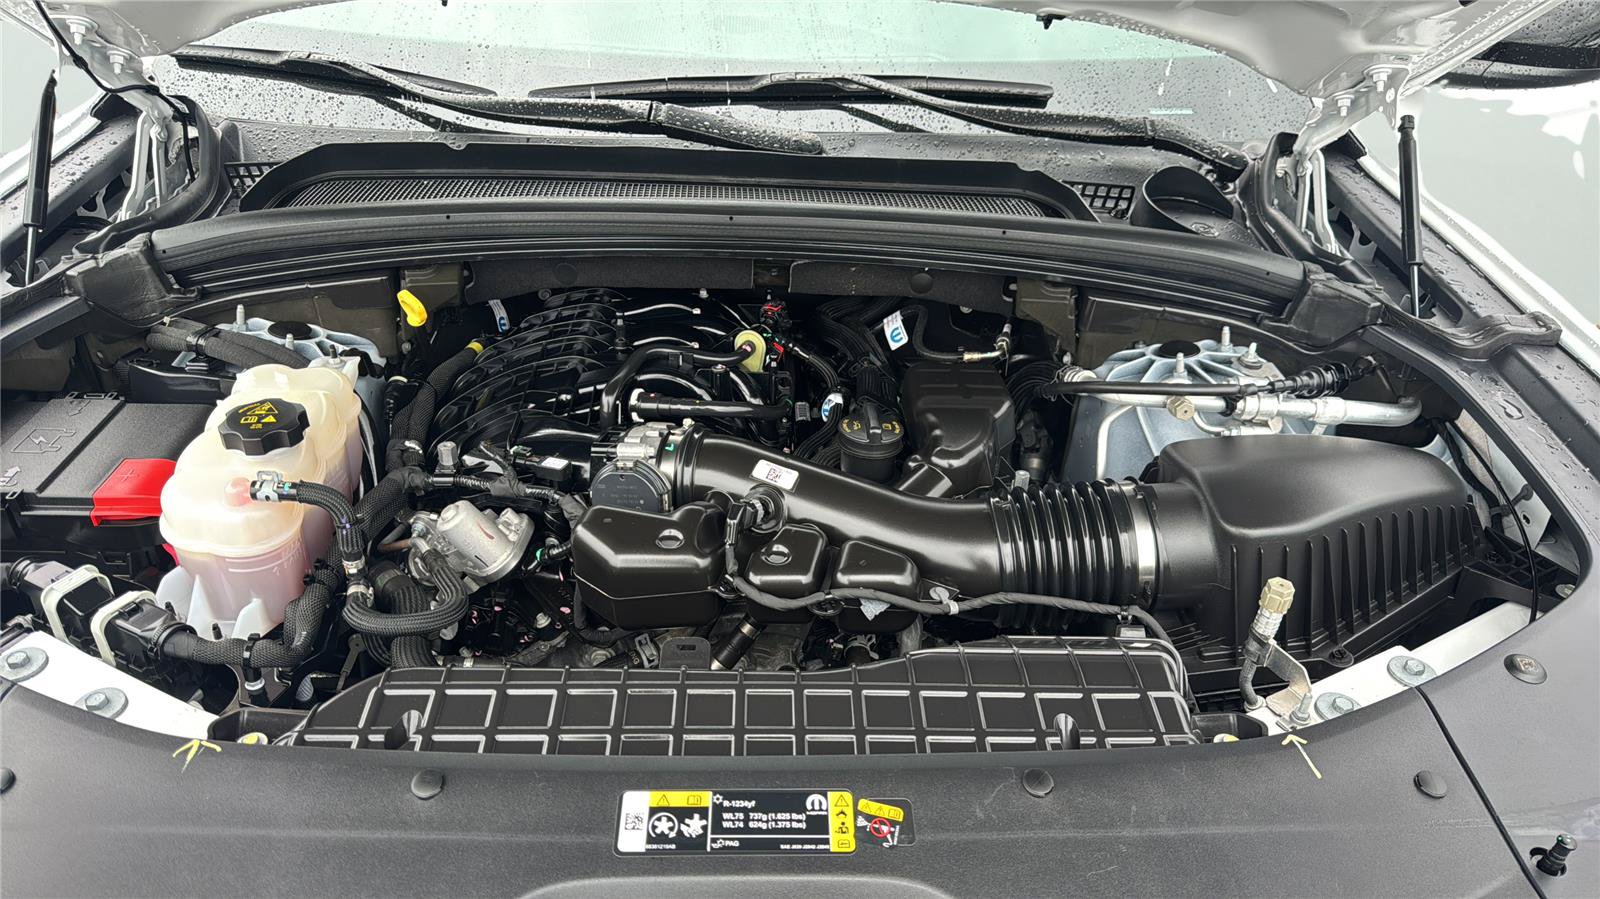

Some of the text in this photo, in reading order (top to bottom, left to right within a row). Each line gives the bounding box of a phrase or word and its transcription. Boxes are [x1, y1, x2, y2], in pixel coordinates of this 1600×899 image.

[723, 800, 756, 808] R-1234yf
[722, 812, 744, 820] WL75
[749, 812, 768, 821] 737g
[768, 812, 791, 821] (1.625
[791, 812, 806, 821] lbs)
[748, 821, 768, 829] 624g
[768, 821, 791, 829] (1.375
[791, 821, 806, 829] lbs)
